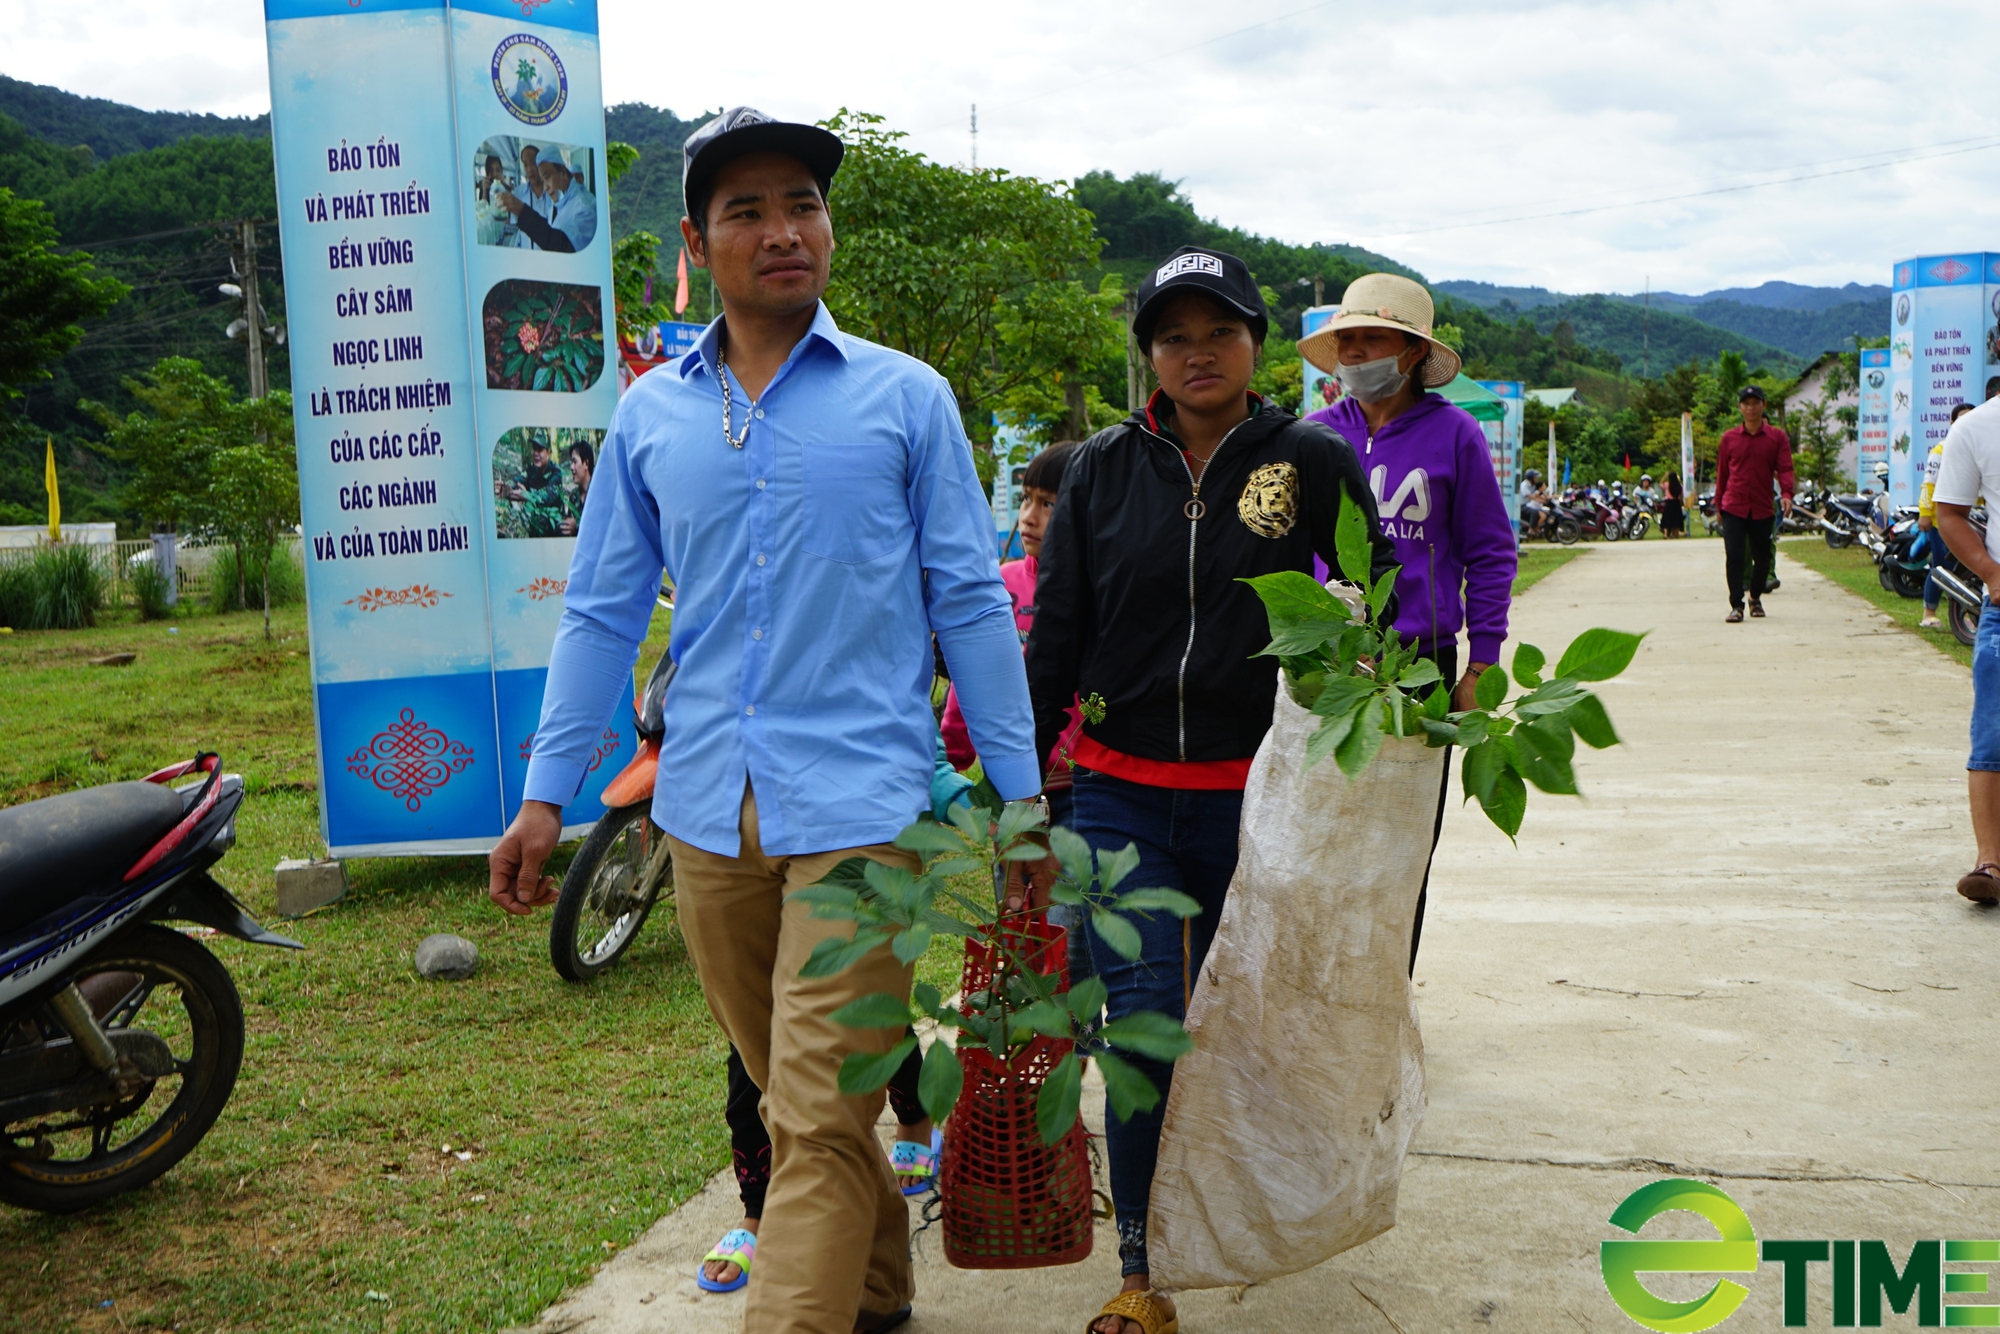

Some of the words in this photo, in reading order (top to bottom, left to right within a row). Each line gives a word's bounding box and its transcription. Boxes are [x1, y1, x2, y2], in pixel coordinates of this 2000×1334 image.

[328, 138, 362, 172] BẢO
[366, 135, 400, 169] TỒN
[305, 192, 328, 223] VÀ
[332, 189, 375, 220] PHÁT
[380, 180, 430, 216] TRIỂN
[328, 236, 363, 270] BỀN
[367, 236, 414, 266] VỮNG
[336, 287, 368, 318] CÂY
[374, 284, 413, 314] SÂM
[332, 339, 379, 370] NGỌC
[384, 335, 423, 362] LINH
[311, 386, 332, 416] LÀ
[336, 383, 391, 414] TRÁCH
[396, 378, 451, 413] NHIỆM
[330, 429, 365, 463] CỦA
[369, 429, 403, 460] CÁC
[408, 422, 445, 458] CẤP,
[340, 480, 373, 511] CÁC
[378, 476, 437, 508] NGÀNH
[313, 531, 336, 561] VÀ
[340, 525, 375, 559] CỦA
[378, 525, 423, 556] TOÀN
[427, 522, 469, 552] DÂN!
[1380, 522, 1424, 540] ALIA
[12, 922, 108, 981] SIRIUS
